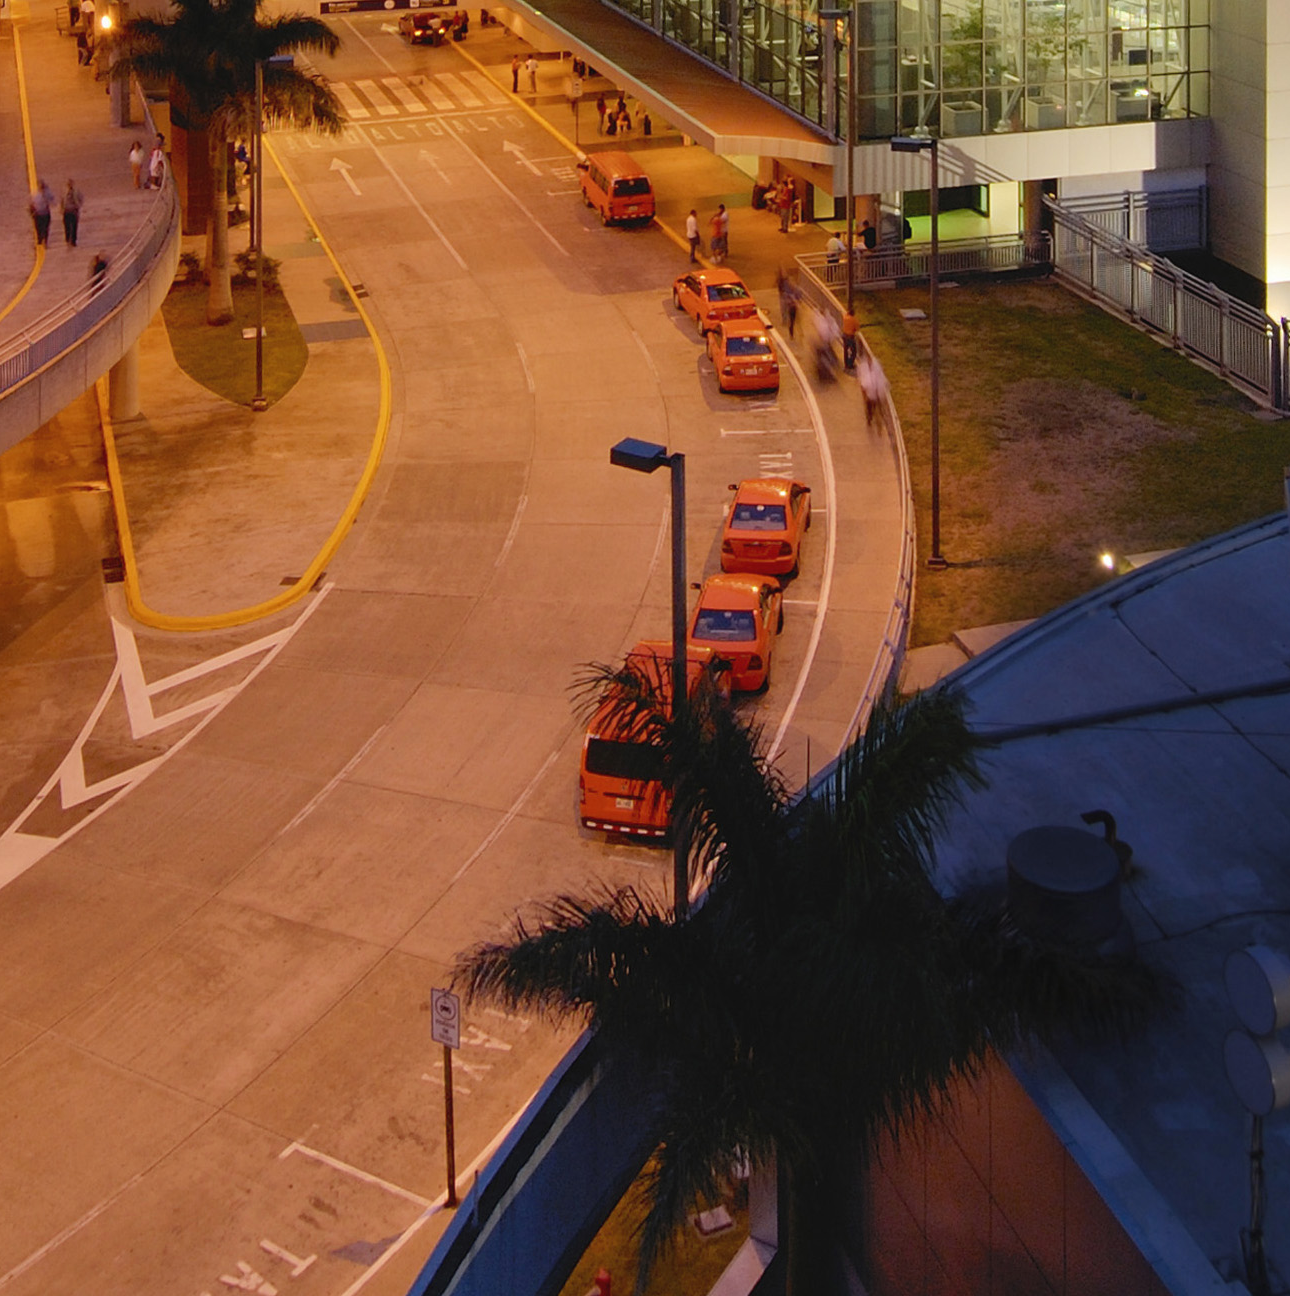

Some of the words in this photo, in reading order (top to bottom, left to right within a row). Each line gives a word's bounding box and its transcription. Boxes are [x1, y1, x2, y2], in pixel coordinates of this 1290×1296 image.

[370, 121, 445, 141] ALTO
[451, 114, 525, 134] ALTO
[759, 452, 793, 479] TAX
